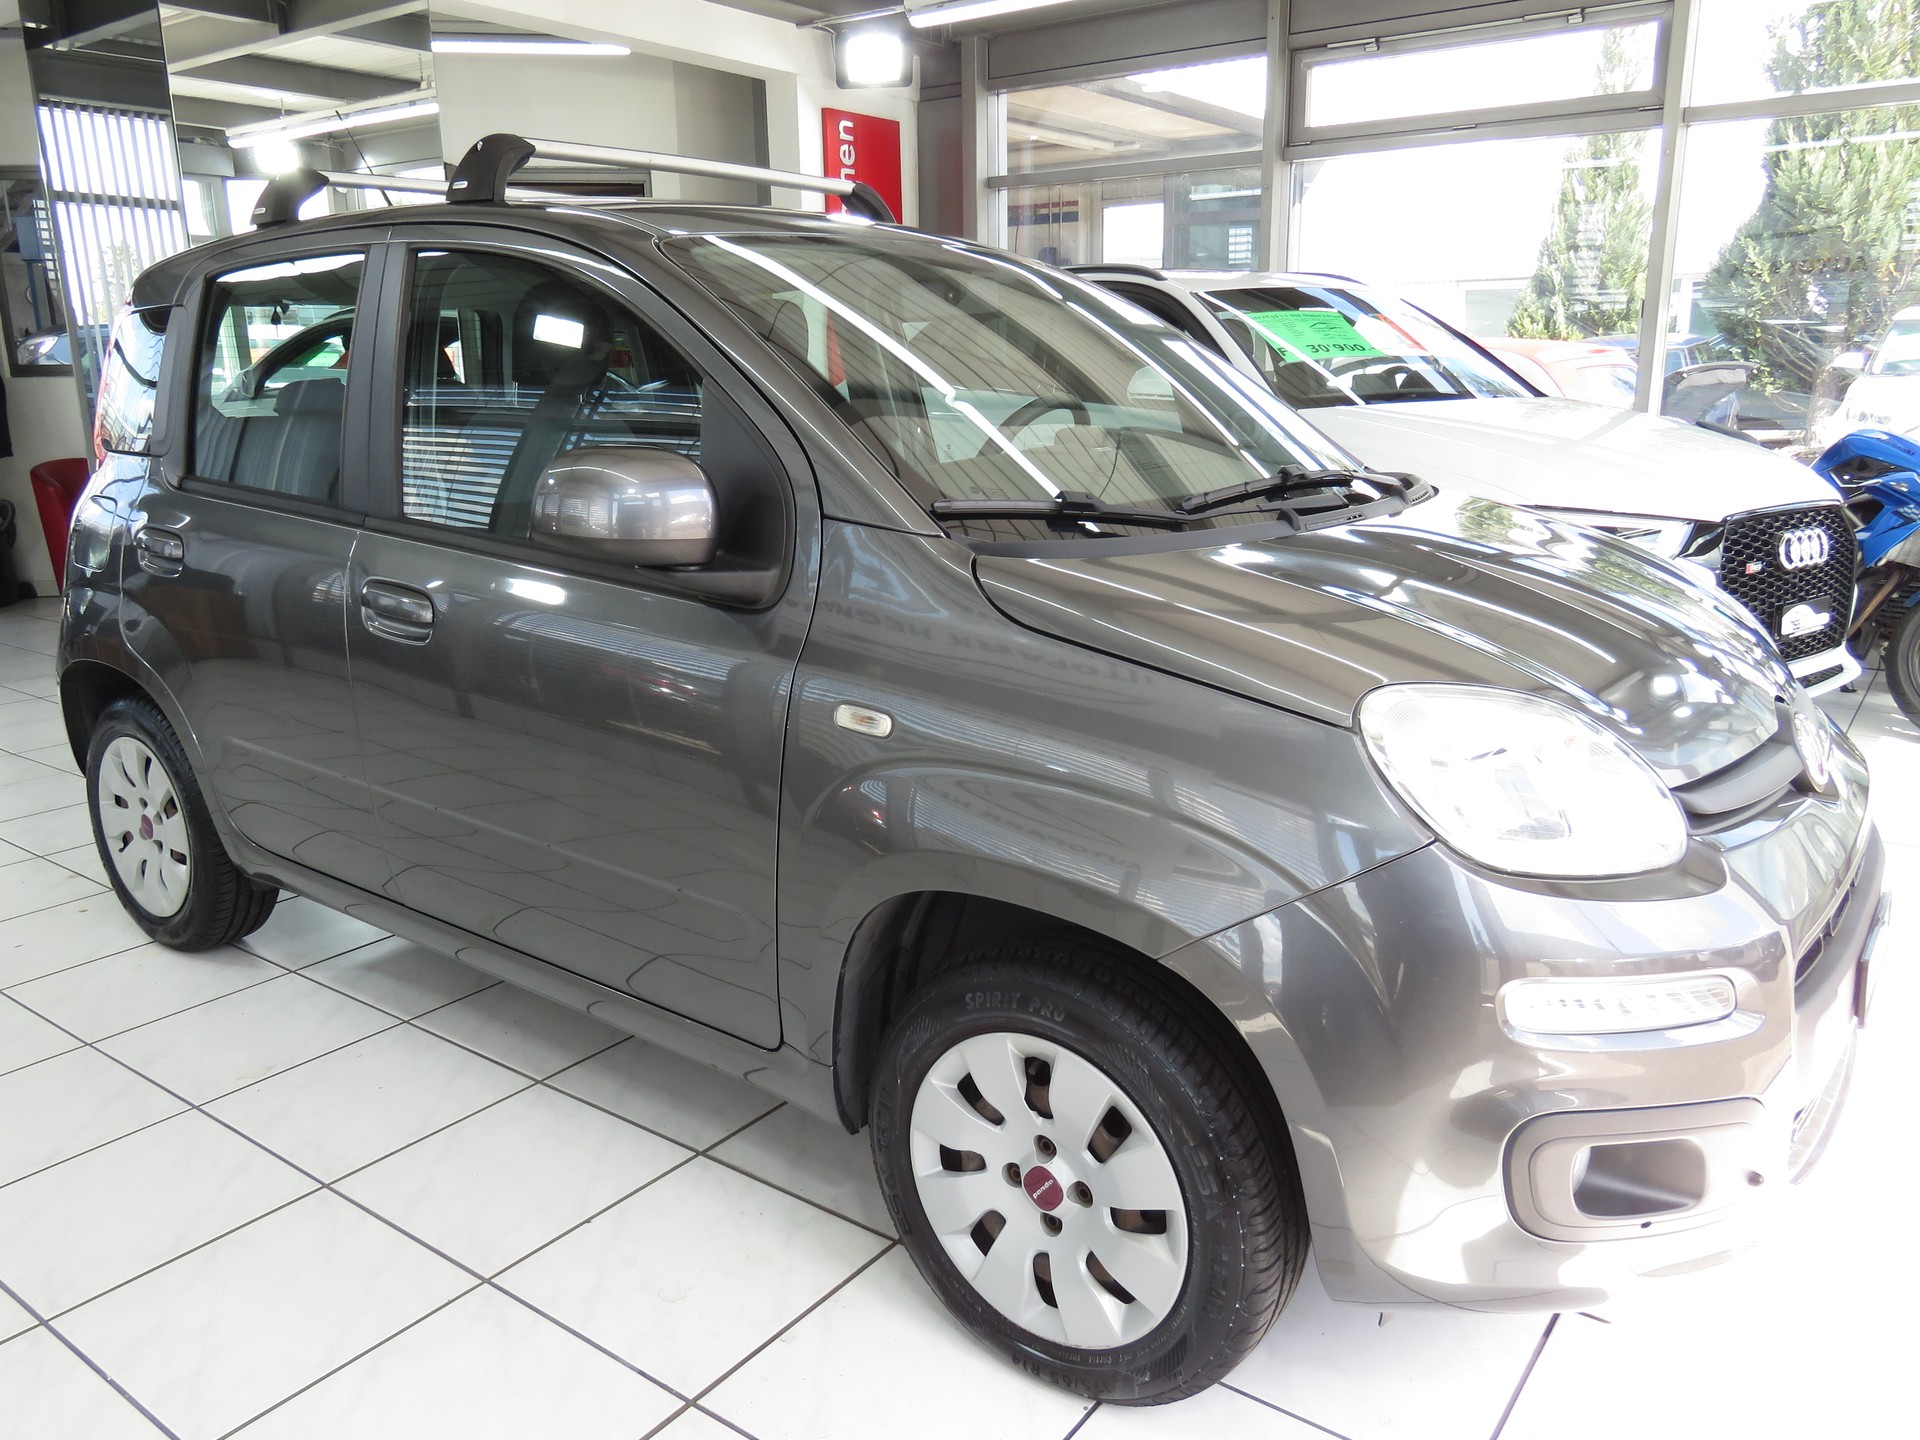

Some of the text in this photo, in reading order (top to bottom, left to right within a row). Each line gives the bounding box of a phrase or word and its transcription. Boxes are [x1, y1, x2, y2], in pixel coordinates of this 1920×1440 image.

[964, 990, 1067, 1022] SPIRIT PRO
[1032, 1179, 1054, 1200] panda
